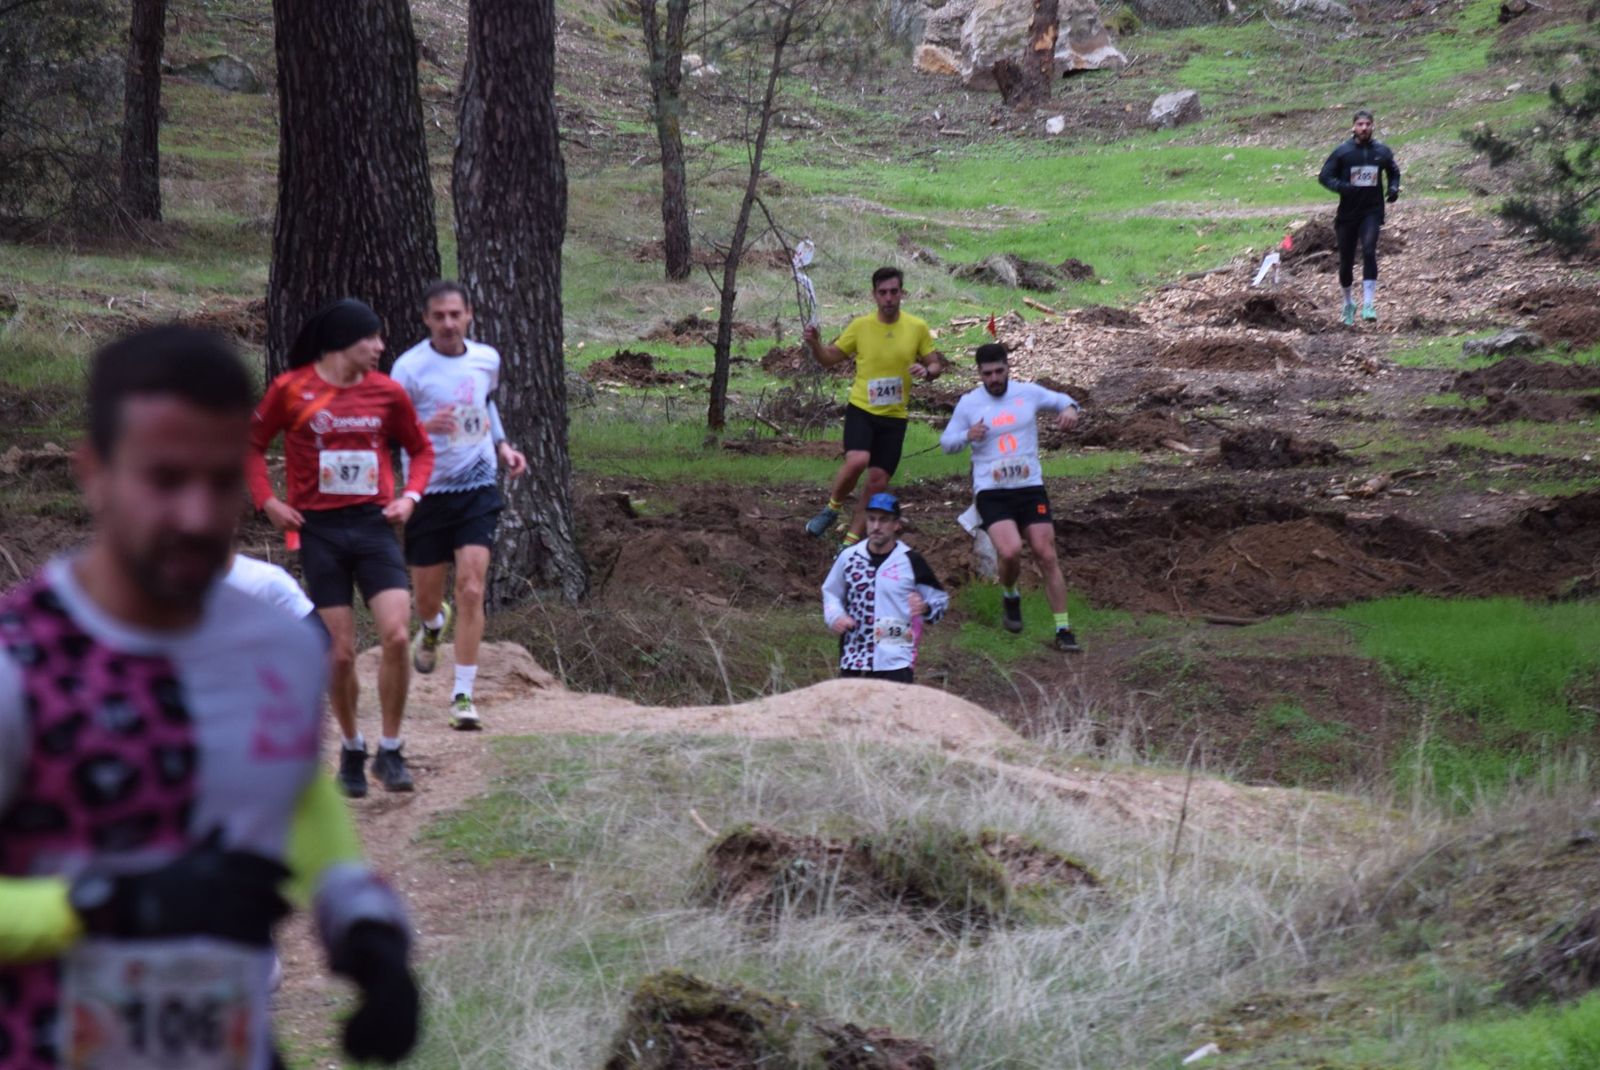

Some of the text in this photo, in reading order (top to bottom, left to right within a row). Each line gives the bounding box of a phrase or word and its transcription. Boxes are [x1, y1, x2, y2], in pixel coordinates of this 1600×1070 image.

[876, 385, 896, 397] 241
[464, 417, 480, 433] 61
[340, 465, 360, 481] 87
[1001, 464, 1022, 479] 139
[888, 626, 901, 637] 13
